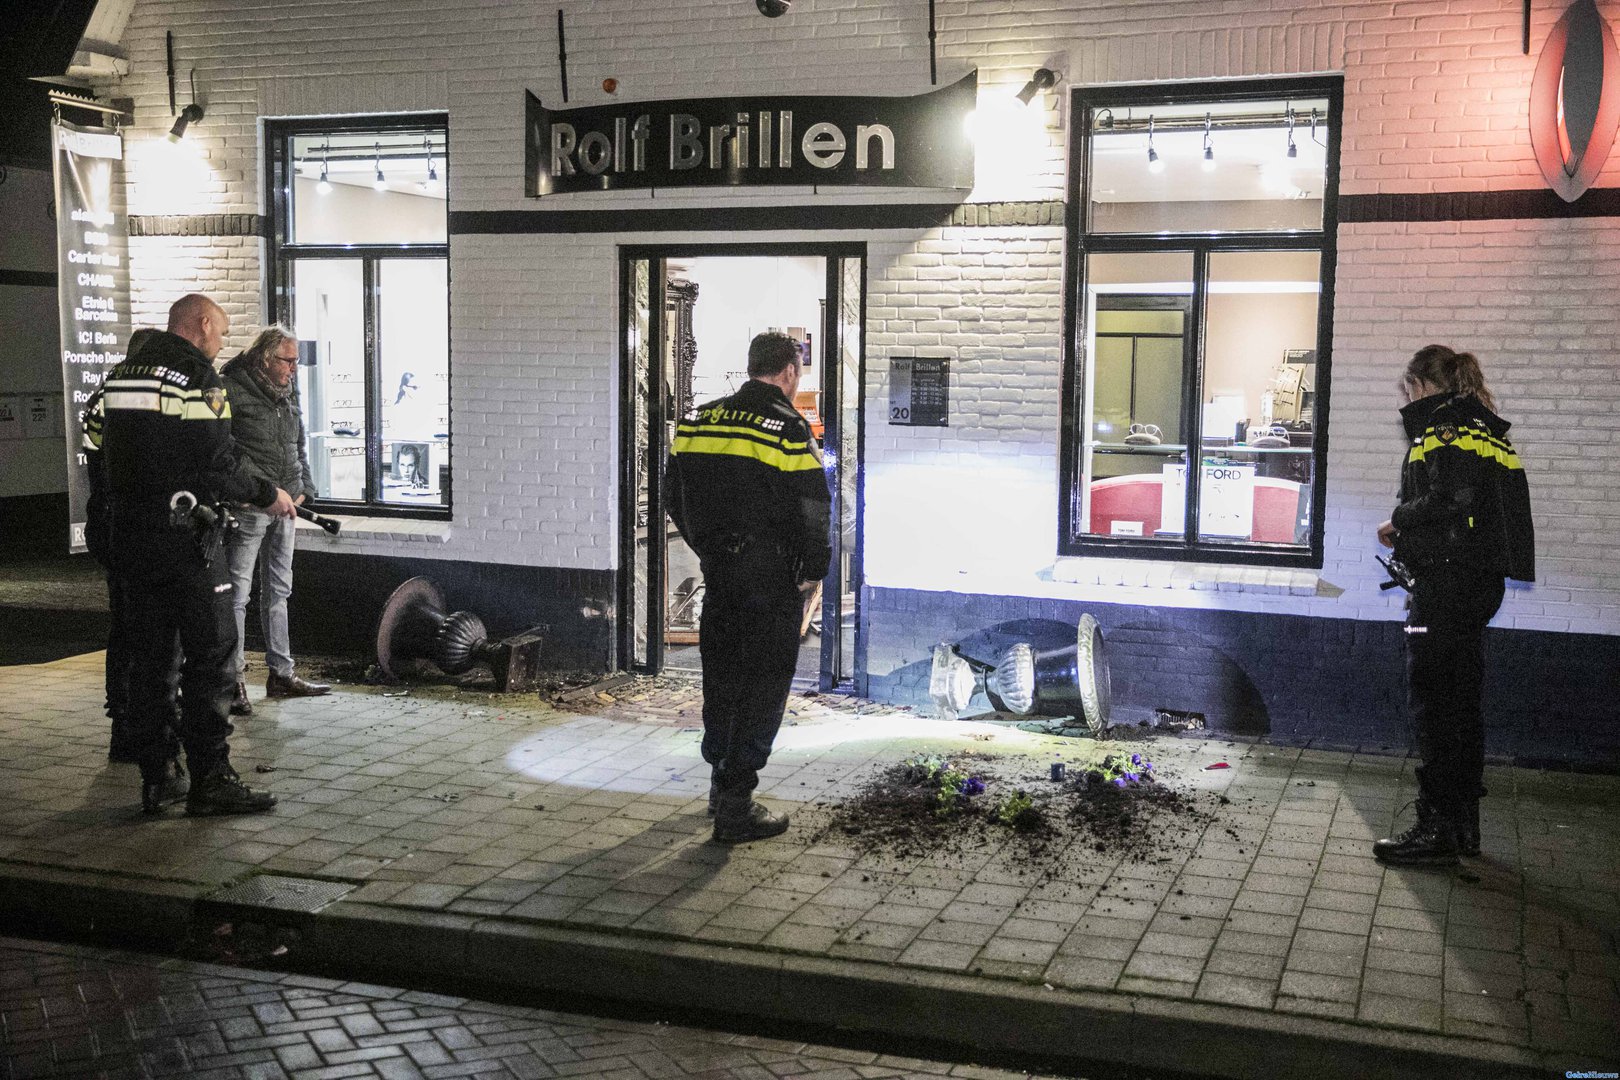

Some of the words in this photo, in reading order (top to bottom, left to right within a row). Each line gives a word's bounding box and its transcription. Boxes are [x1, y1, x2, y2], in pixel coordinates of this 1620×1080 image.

[551, 114, 650, 177] Rolf
[670, 110, 895, 171] Brillen
[64, 350, 104, 363] Porsche
[82, 370, 101, 387] Ray
[893, 407, 909, 419] 20
[1206, 468, 1241, 480] FORD
